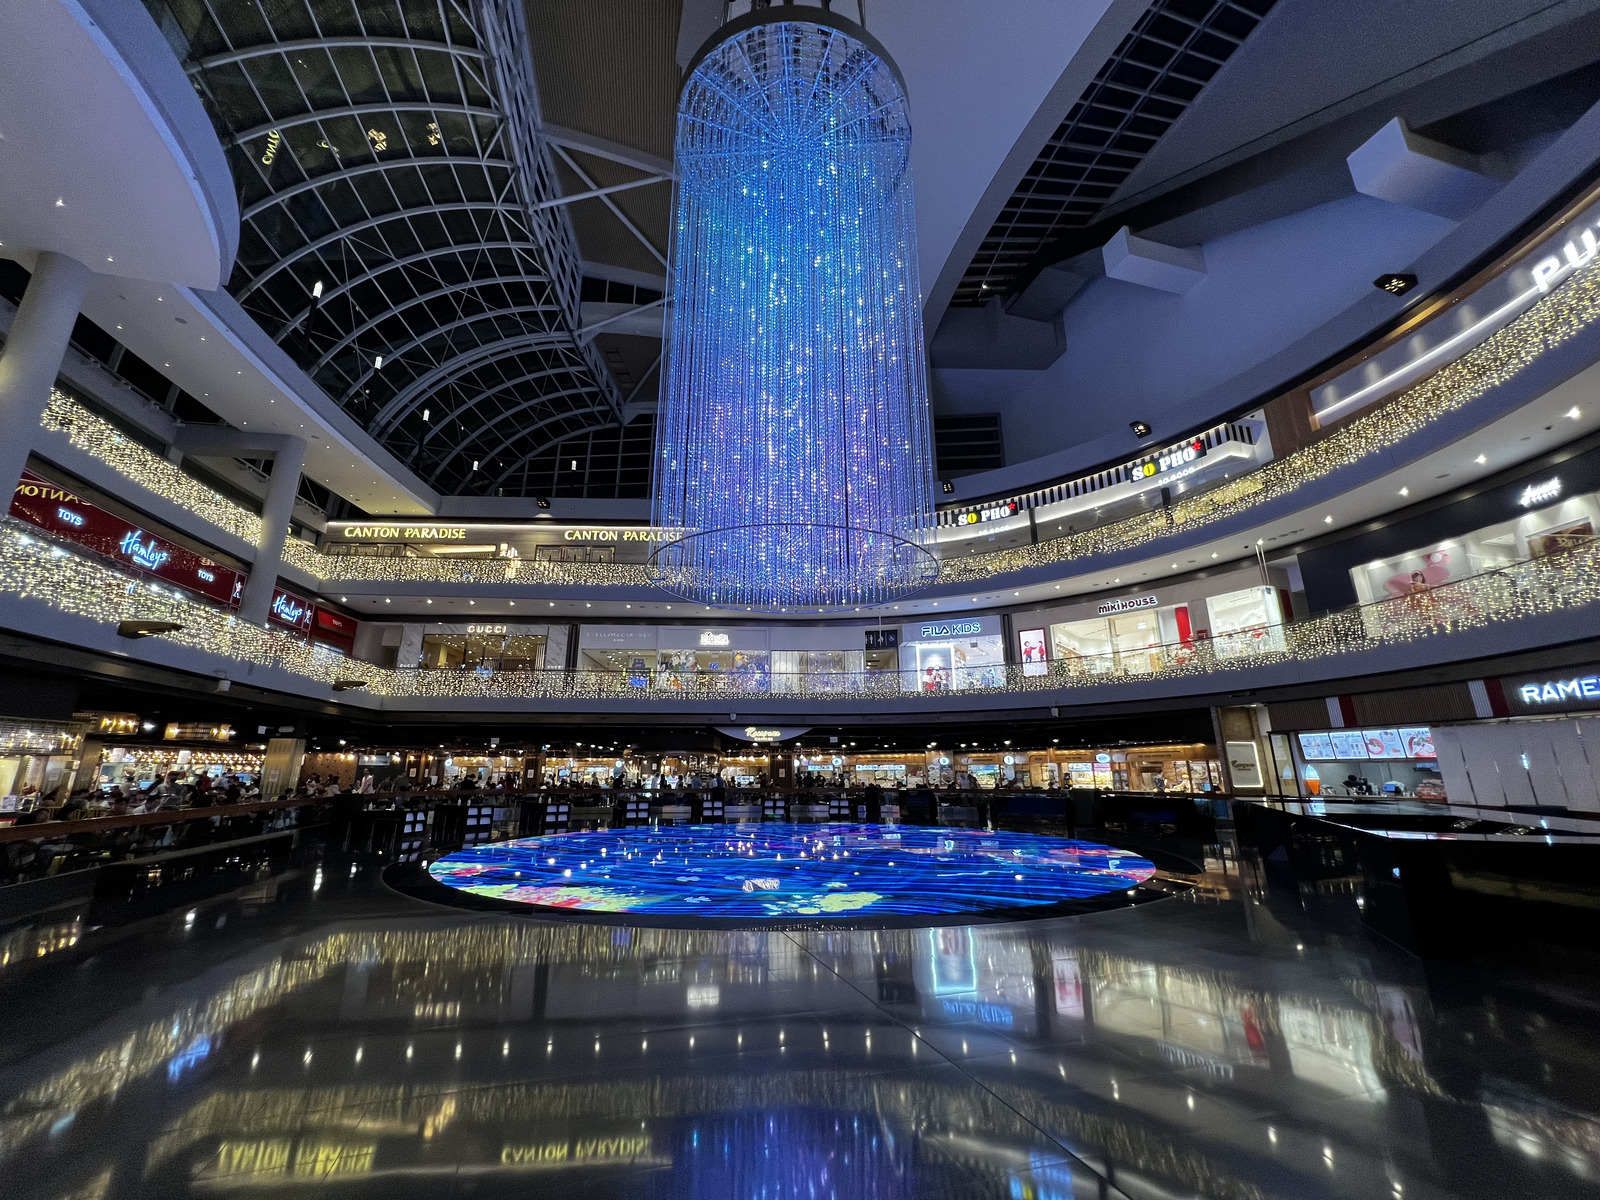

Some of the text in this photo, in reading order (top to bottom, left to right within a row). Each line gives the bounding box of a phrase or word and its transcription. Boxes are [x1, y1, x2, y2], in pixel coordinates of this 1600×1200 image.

[1531, 219, 1600, 293] PU
[1131, 446, 1196, 482] SO PHO
[58, 507, 83, 526] TOYS
[957, 505, 1010, 526] SO PHO
[344, 526, 467, 540] CANTON PARADISE
[564, 529, 683, 543] CANTON PARADISE
[119, 530, 168, 570] Hamleys
[197, 568, 215, 582] TOYS
[272, 594, 303, 623] Hamleys
[466, 625, 508, 634] GUCCI
[921, 622, 981, 638] FILA KIDS
[1519, 677, 1600, 705] RAME
